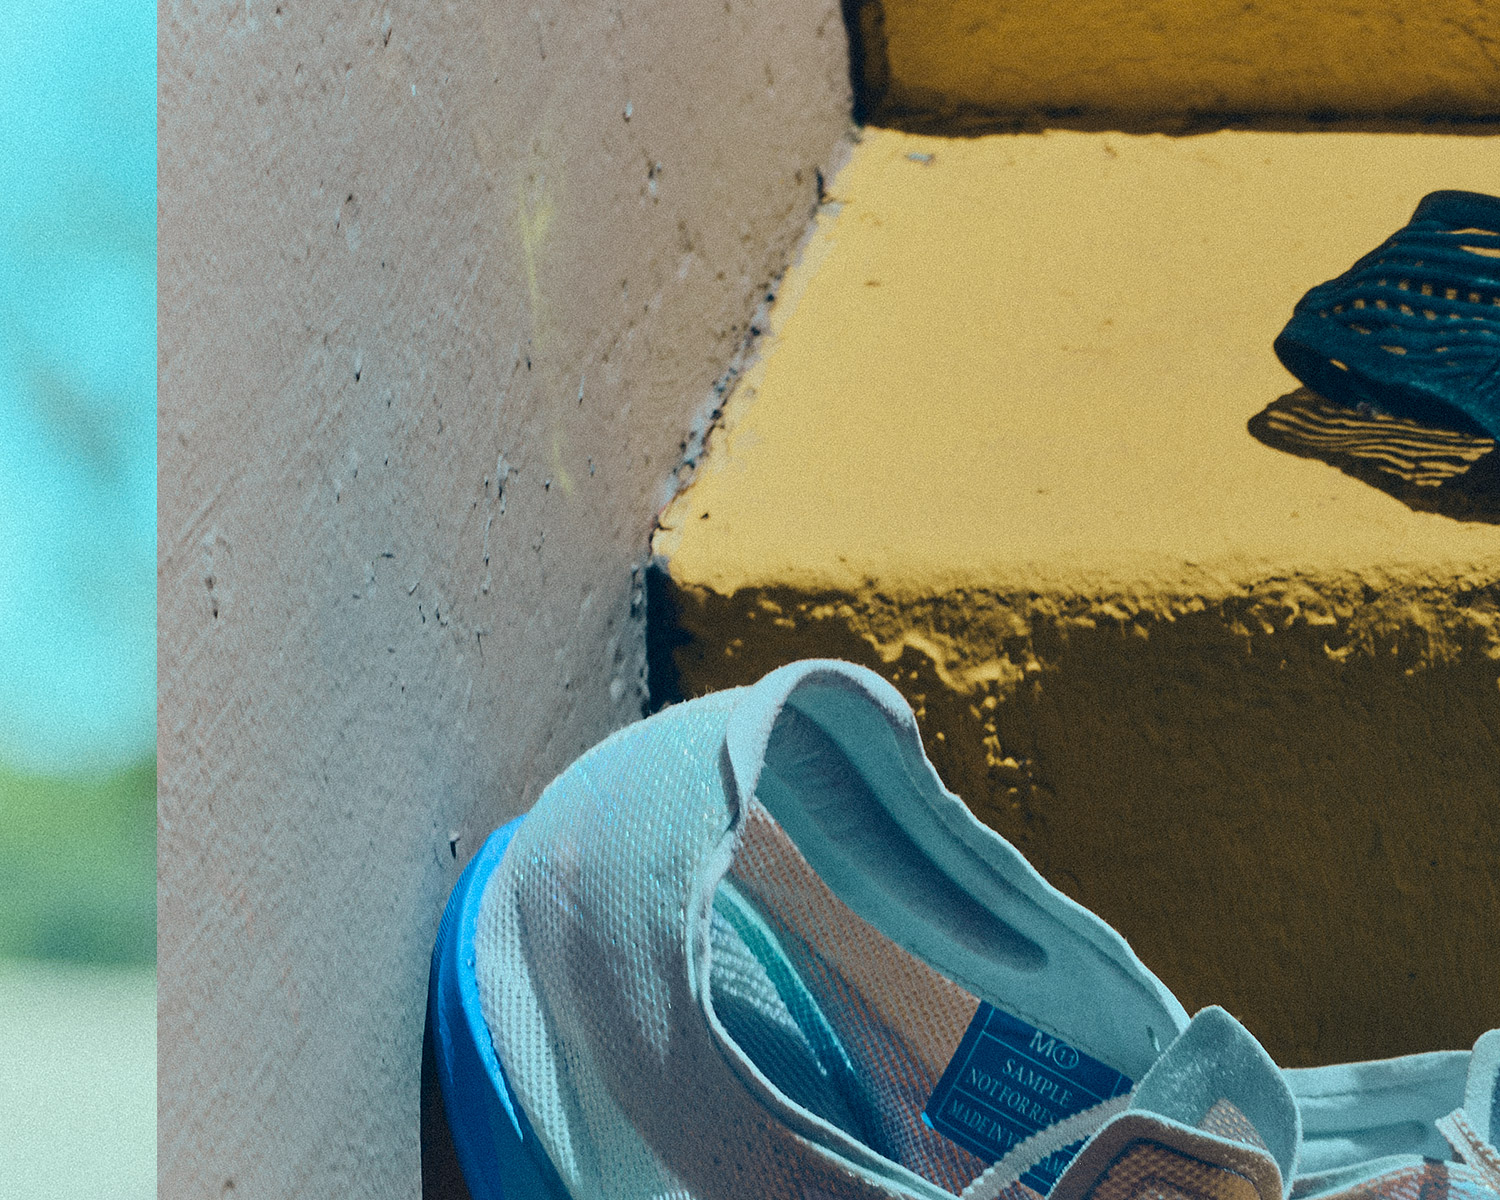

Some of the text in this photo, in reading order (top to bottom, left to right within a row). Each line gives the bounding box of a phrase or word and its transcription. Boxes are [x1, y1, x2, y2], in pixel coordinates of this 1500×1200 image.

[966, 1066, 1002, 1096] NOT
[998, 1085, 1031, 1115] FOR
[1002, 1058, 1073, 1108] SAMPLE
[949, 1099, 1009, 1143] MADE IN
